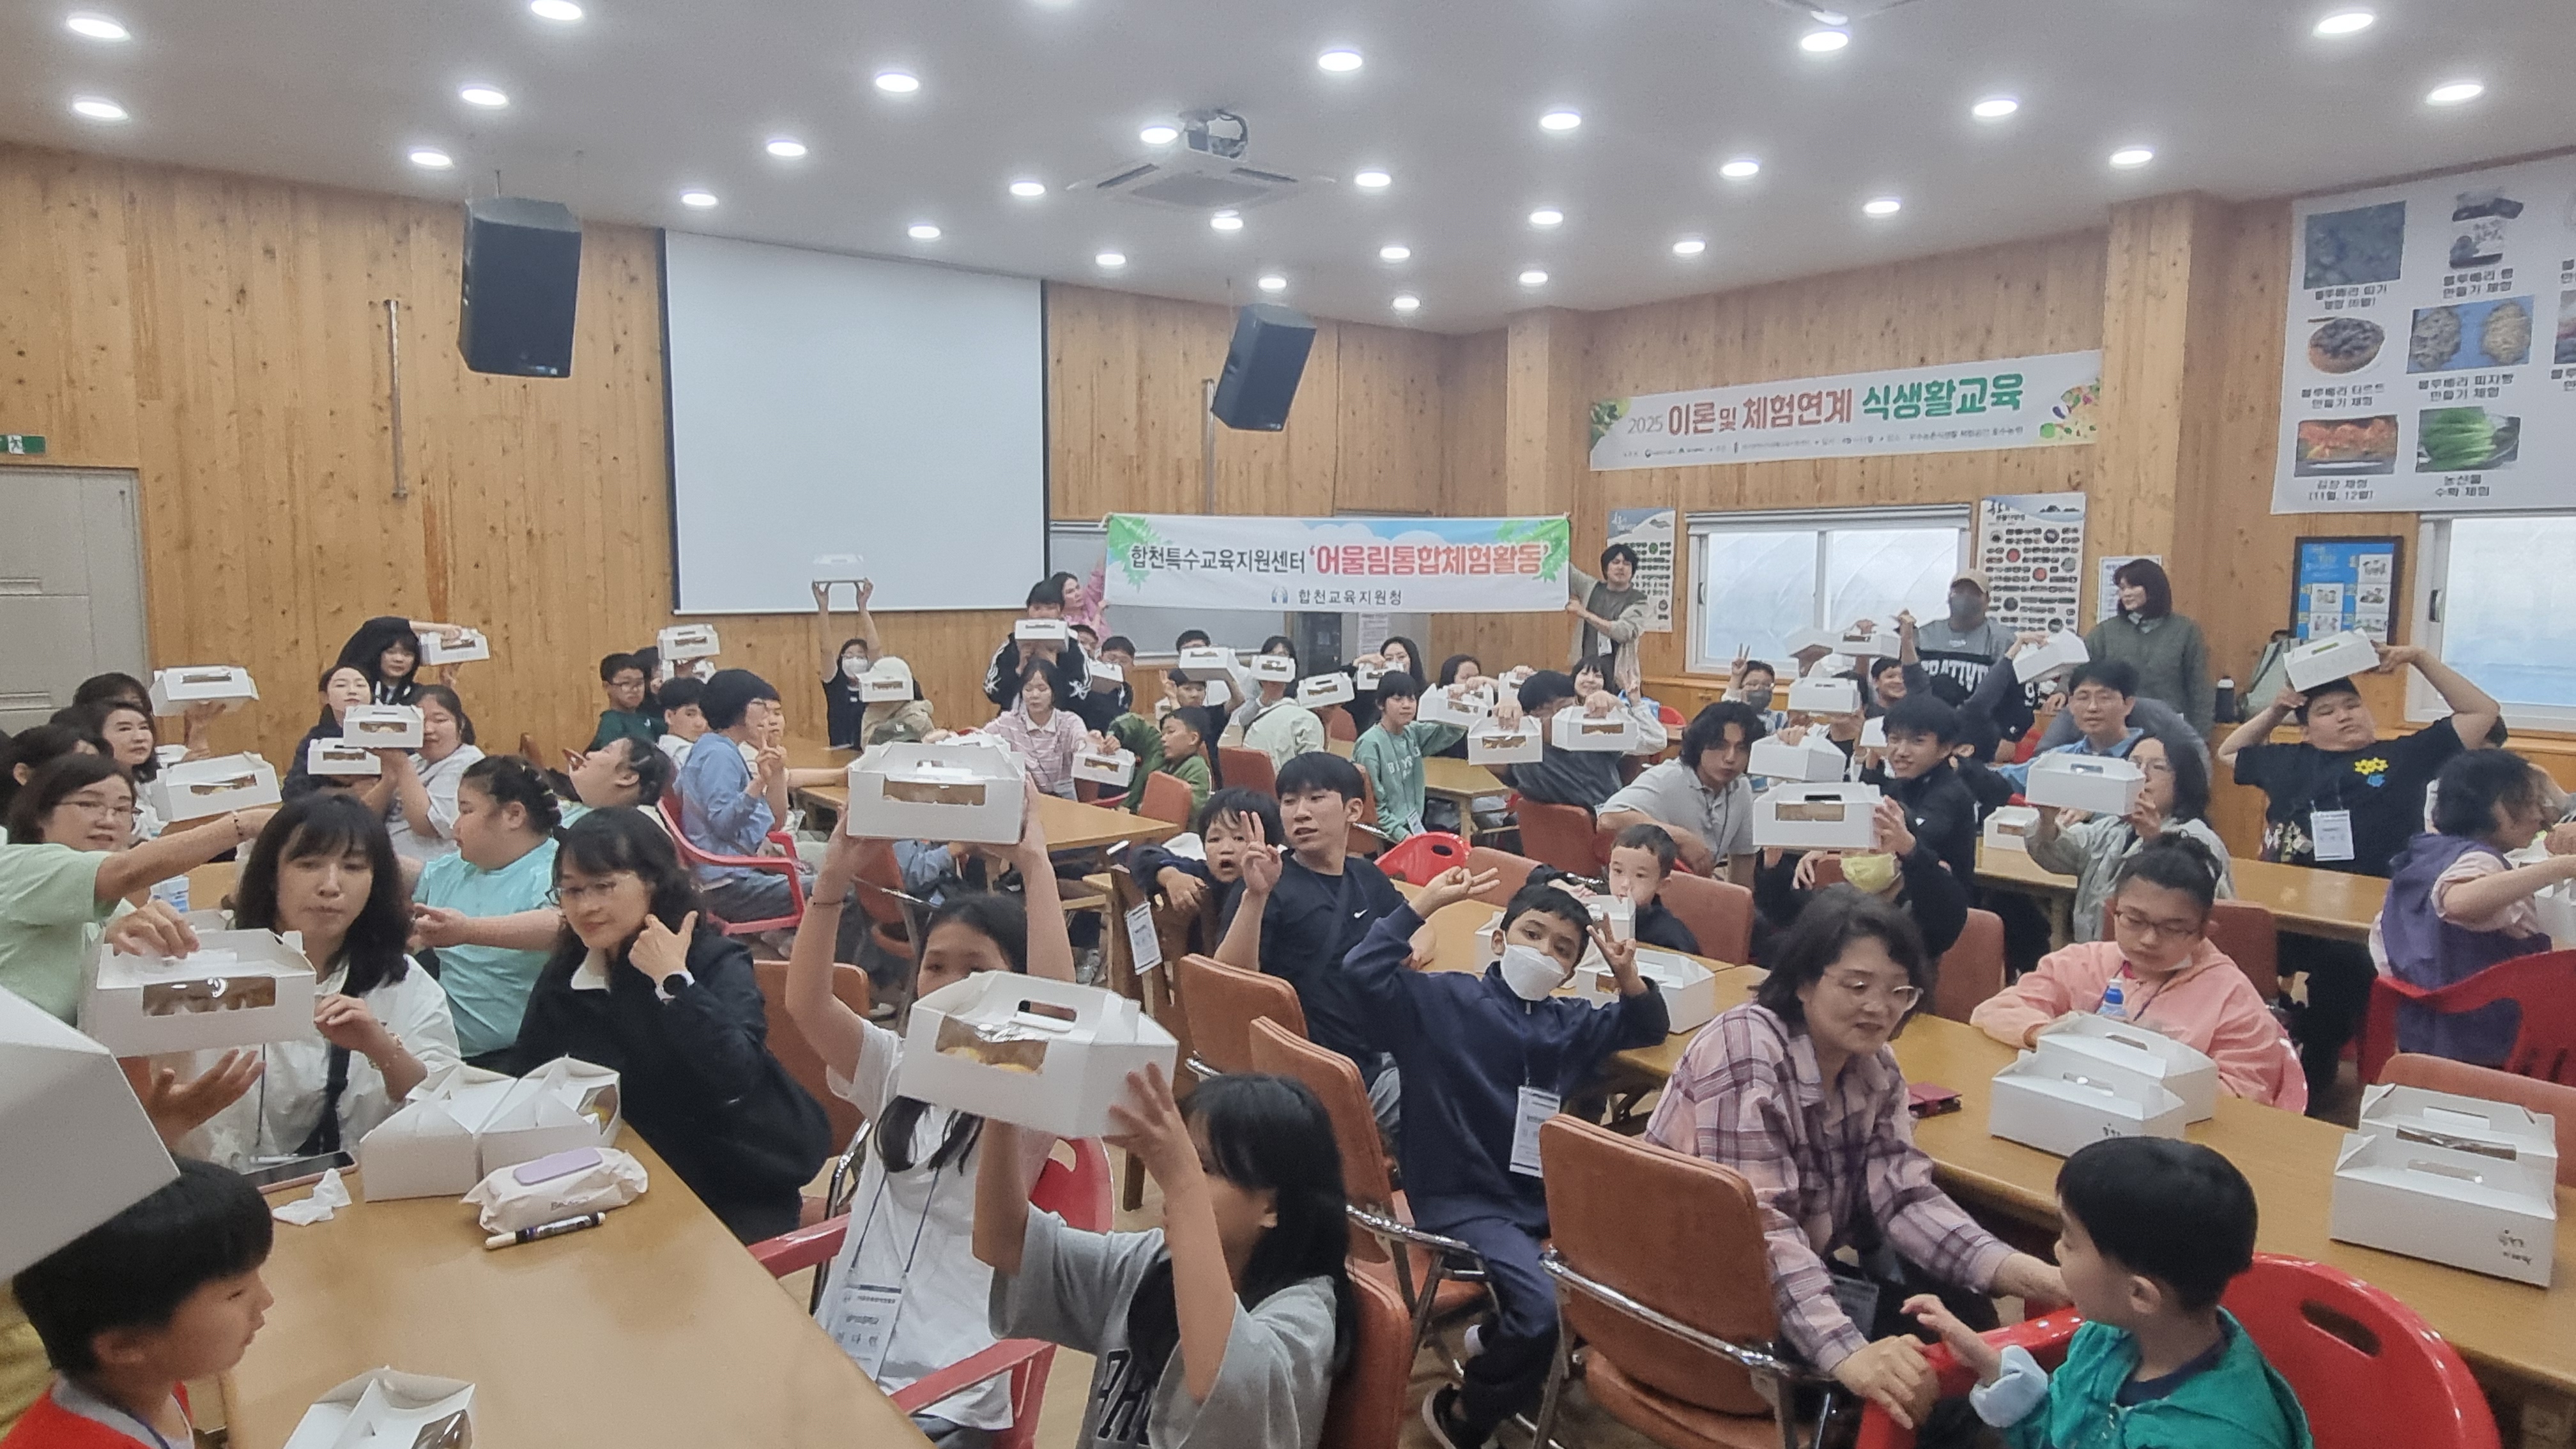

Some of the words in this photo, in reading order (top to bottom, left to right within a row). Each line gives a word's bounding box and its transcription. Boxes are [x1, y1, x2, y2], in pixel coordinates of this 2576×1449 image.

[1629, 415, 1664, 434] 2025
[1669, 402, 1715, 436] 이론
[1719, 406, 1737, 433] 및
[1742, 388, 1853, 430] 체험연계
[1862, 373, 2024, 420] 식생활교육
[2431, 389, 2468, 401] 만들기
[1131, 545, 1305, 574] 합천특수교육지원센터
[1298, 588, 1403, 606] 합천교육지원청
